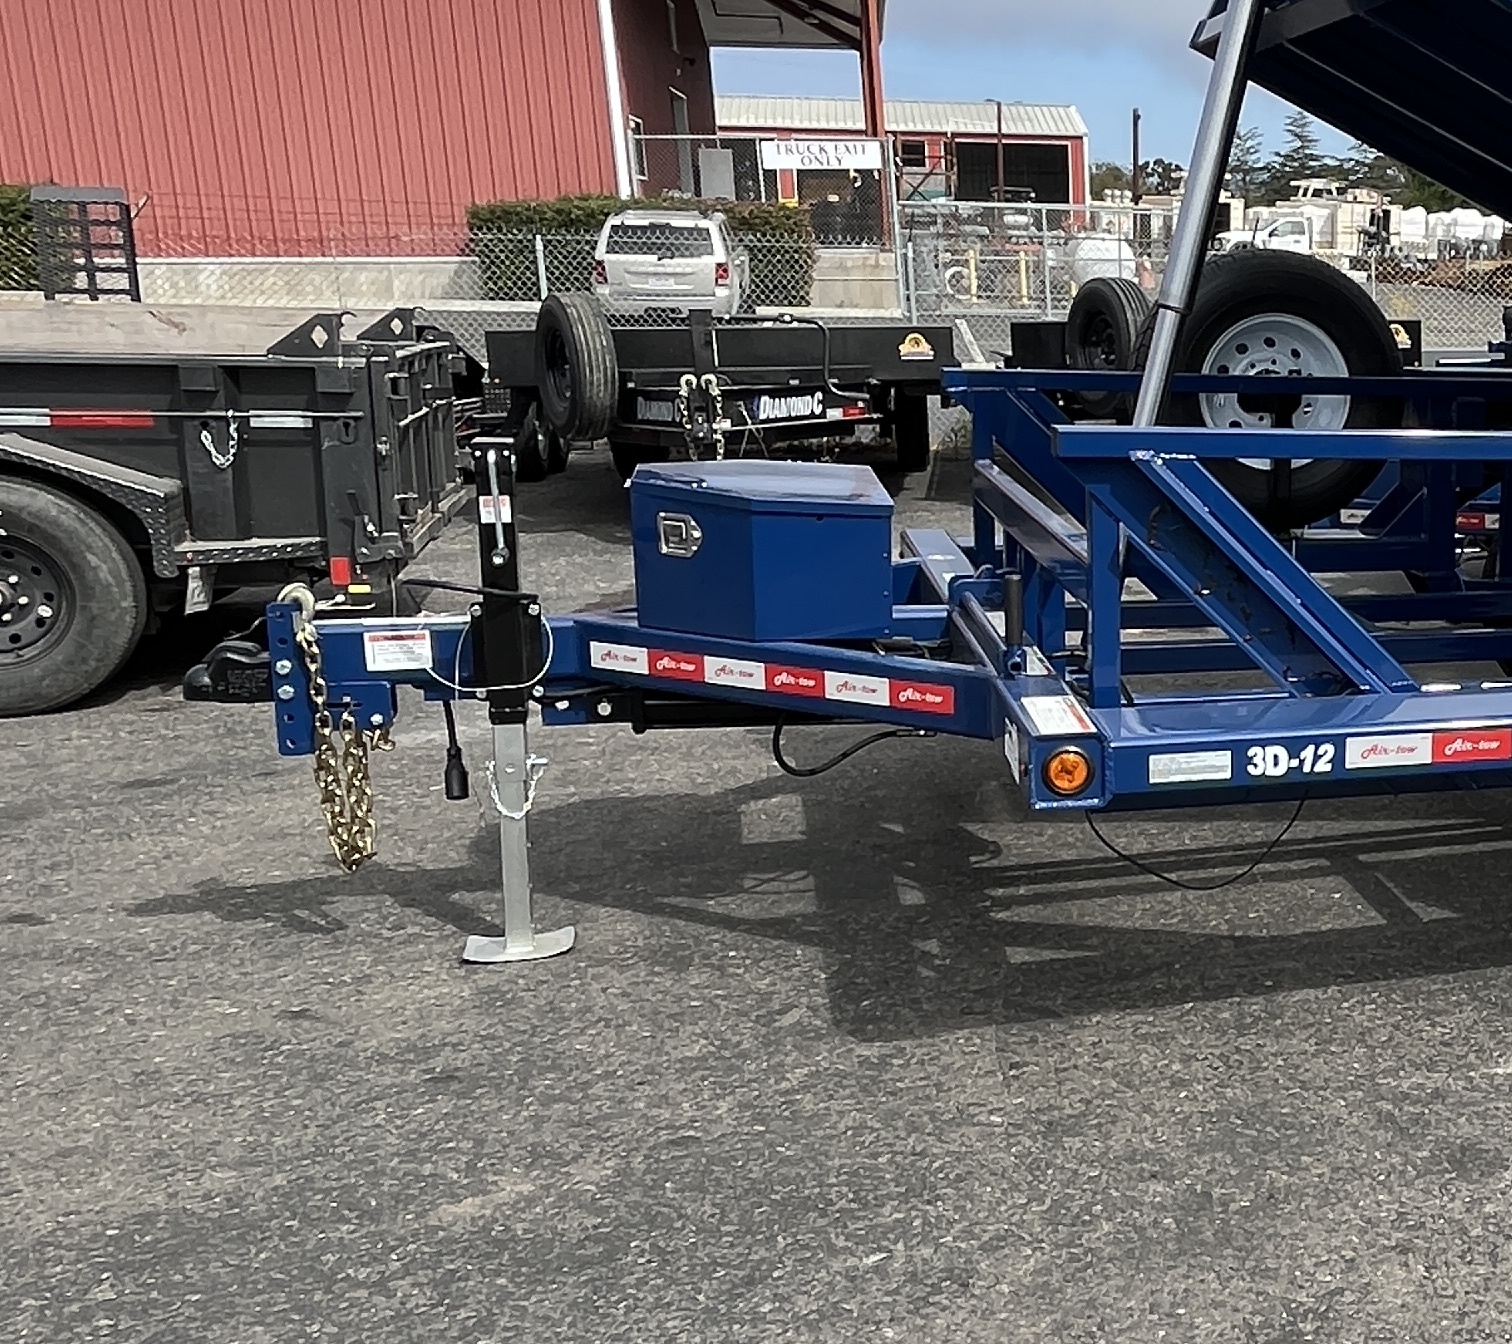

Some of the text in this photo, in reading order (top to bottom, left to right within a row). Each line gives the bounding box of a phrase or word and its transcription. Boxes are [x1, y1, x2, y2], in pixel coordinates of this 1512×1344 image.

[776, 143, 866, 155] TRUCK EXIT
[800, 155, 843, 167] ONLY
[759, 391, 823, 419] DIAMOND C
[601, 650, 943, 703] Air-tow Air-tow Air-tow Air-tow Air-tow Air-tow
[1246, 742, 1335, 777] 3D-12
[1361, 742, 1418, 759] Air-tow
[1444, 737, 1500, 756] Air-tow
